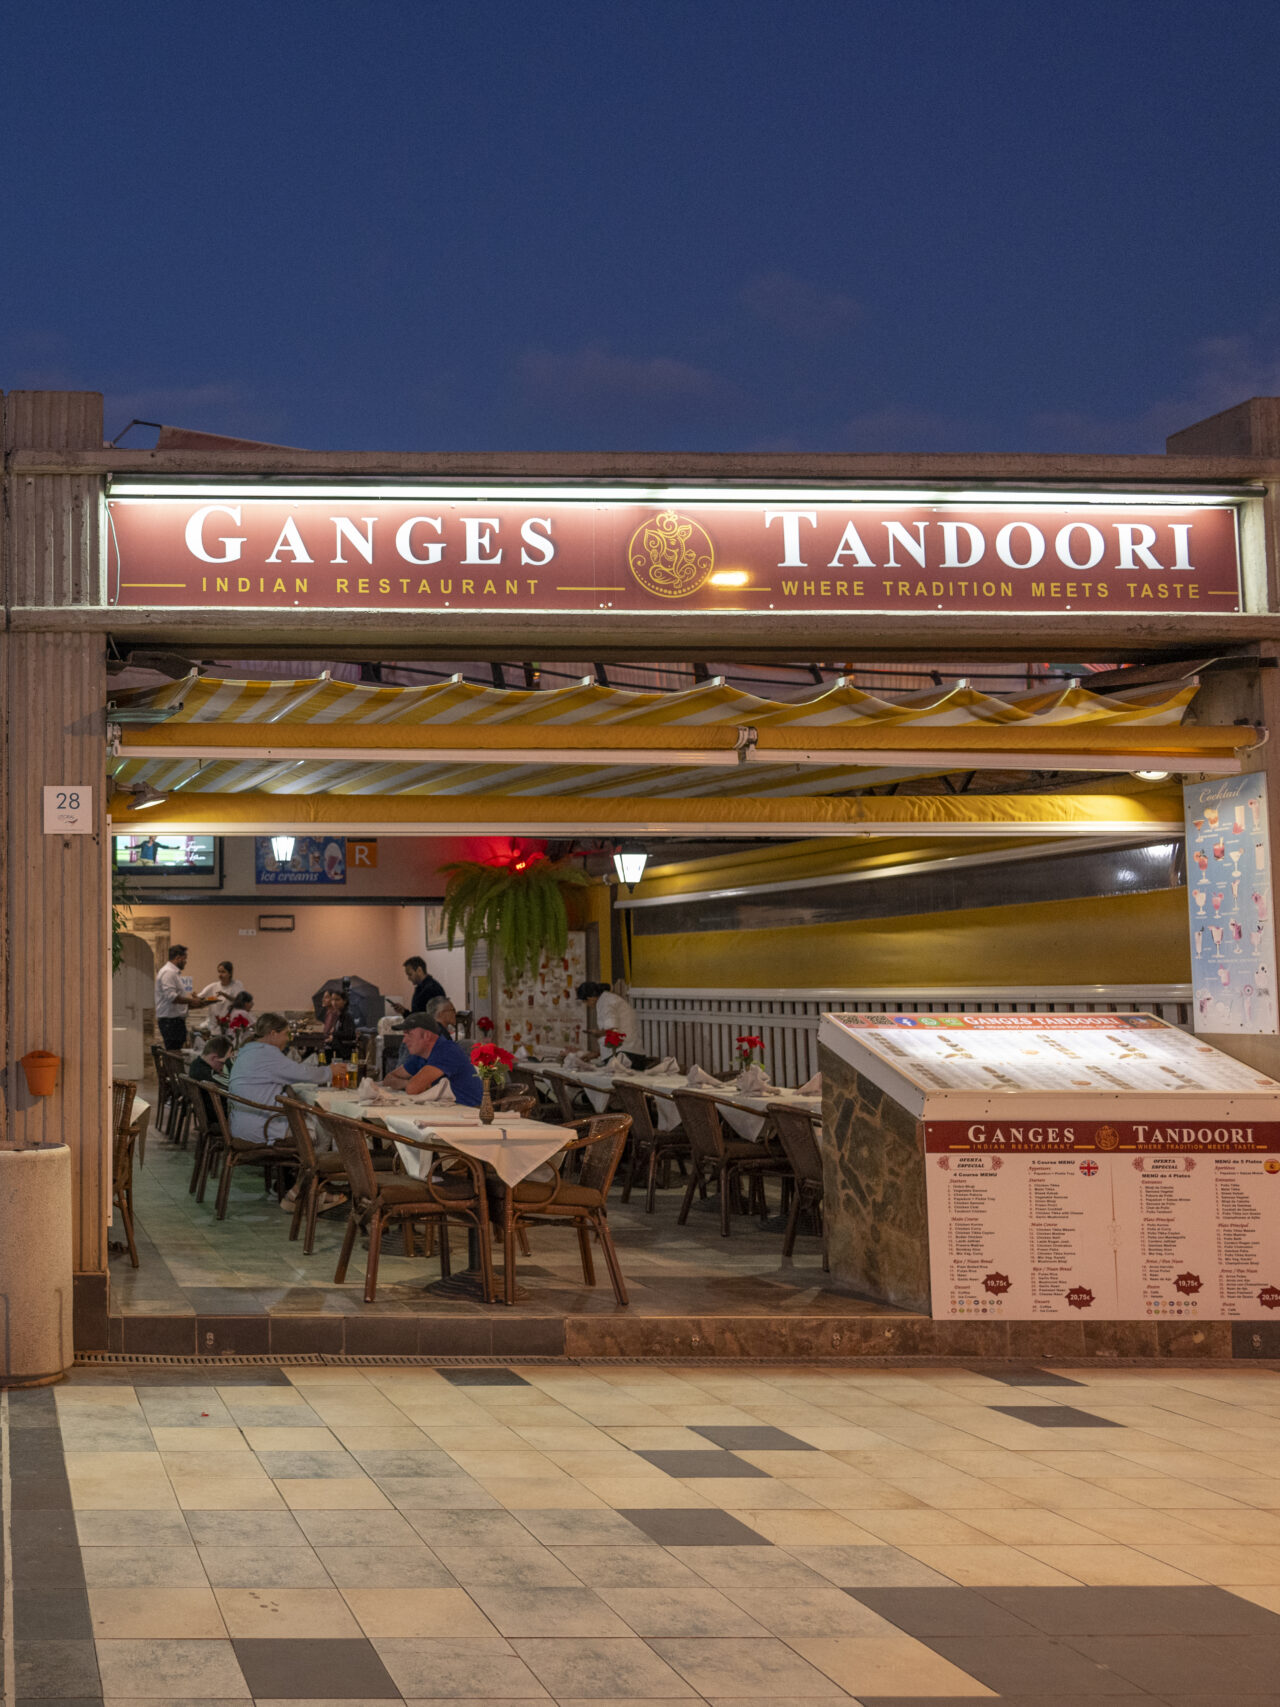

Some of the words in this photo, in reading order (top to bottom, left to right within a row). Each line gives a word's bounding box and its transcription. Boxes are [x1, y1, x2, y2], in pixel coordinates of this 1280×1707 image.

[184, 504, 555, 566] GANGES
[764, 511, 1196, 571] TANDOORI
[201, 577, 309, 593] INDIAN
[336, 578, 540, 595] RESTAURANT
[781, 580, 865, 597] WHERE
[882, 581, 1014, 598] TRADITION
[1031, 582, 1110, 599] MEETS
[1126, 583, 1201, 600] TASTE
[1200, 778, 1248, 803] Cocktail
[56, 792, 80, 810] 28
[354, 845, 371, 865] R
[261, 871, 275, 881] ice
[278, 872, 319, 881] creams
[963, 1016, 1032, 1025] GANGES
[1032, 1017, 1120, 1025] TANDOORI
[968, 1125, 1075, 1143] GANGES
[1133, 1126, 1254, 1144] TANDOORI
